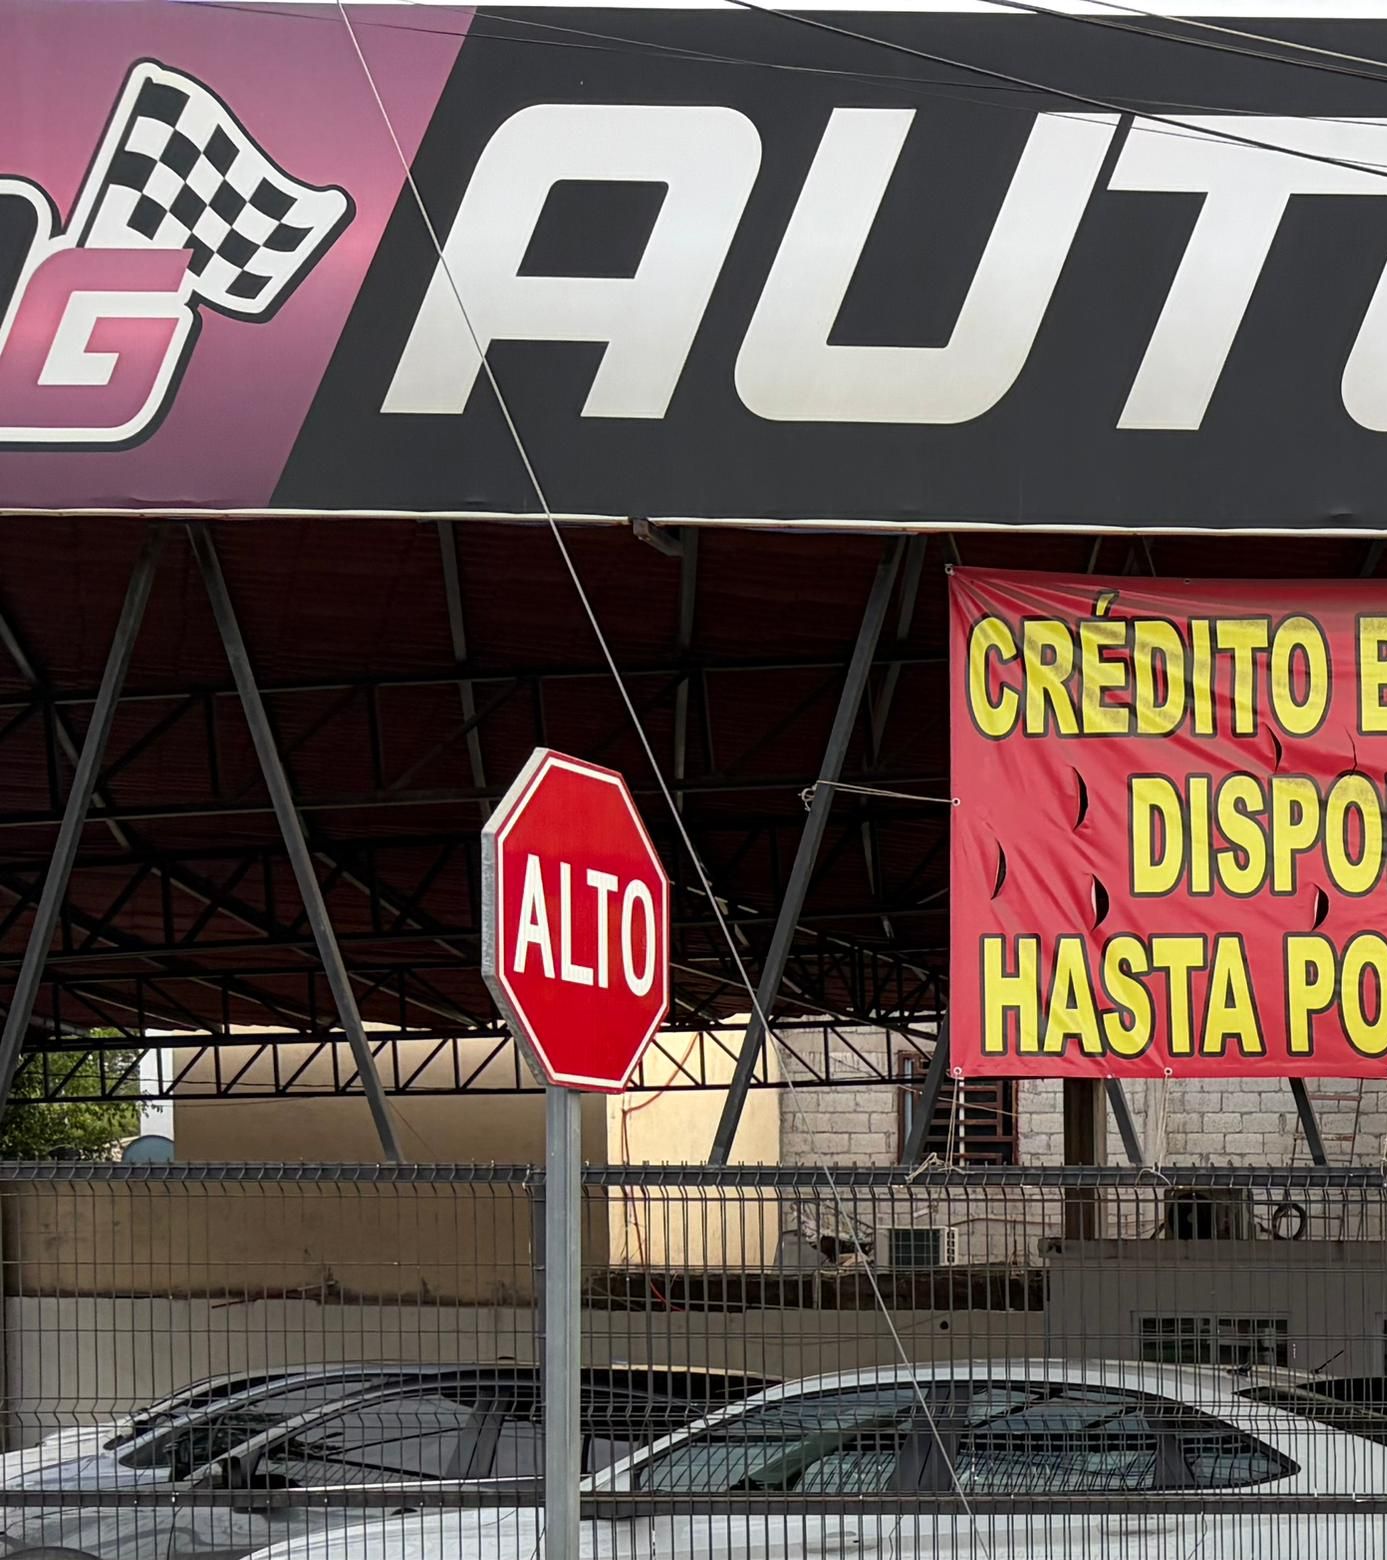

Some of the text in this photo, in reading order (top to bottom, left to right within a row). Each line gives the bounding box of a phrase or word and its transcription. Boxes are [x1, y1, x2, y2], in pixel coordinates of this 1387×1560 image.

[0, 180, 195, 430] G
[966, 589, 1330, 738] CRÉDITO
[513, 853, 656, 997] ALTO
[979, 931, 1266, 1059] HASTA
